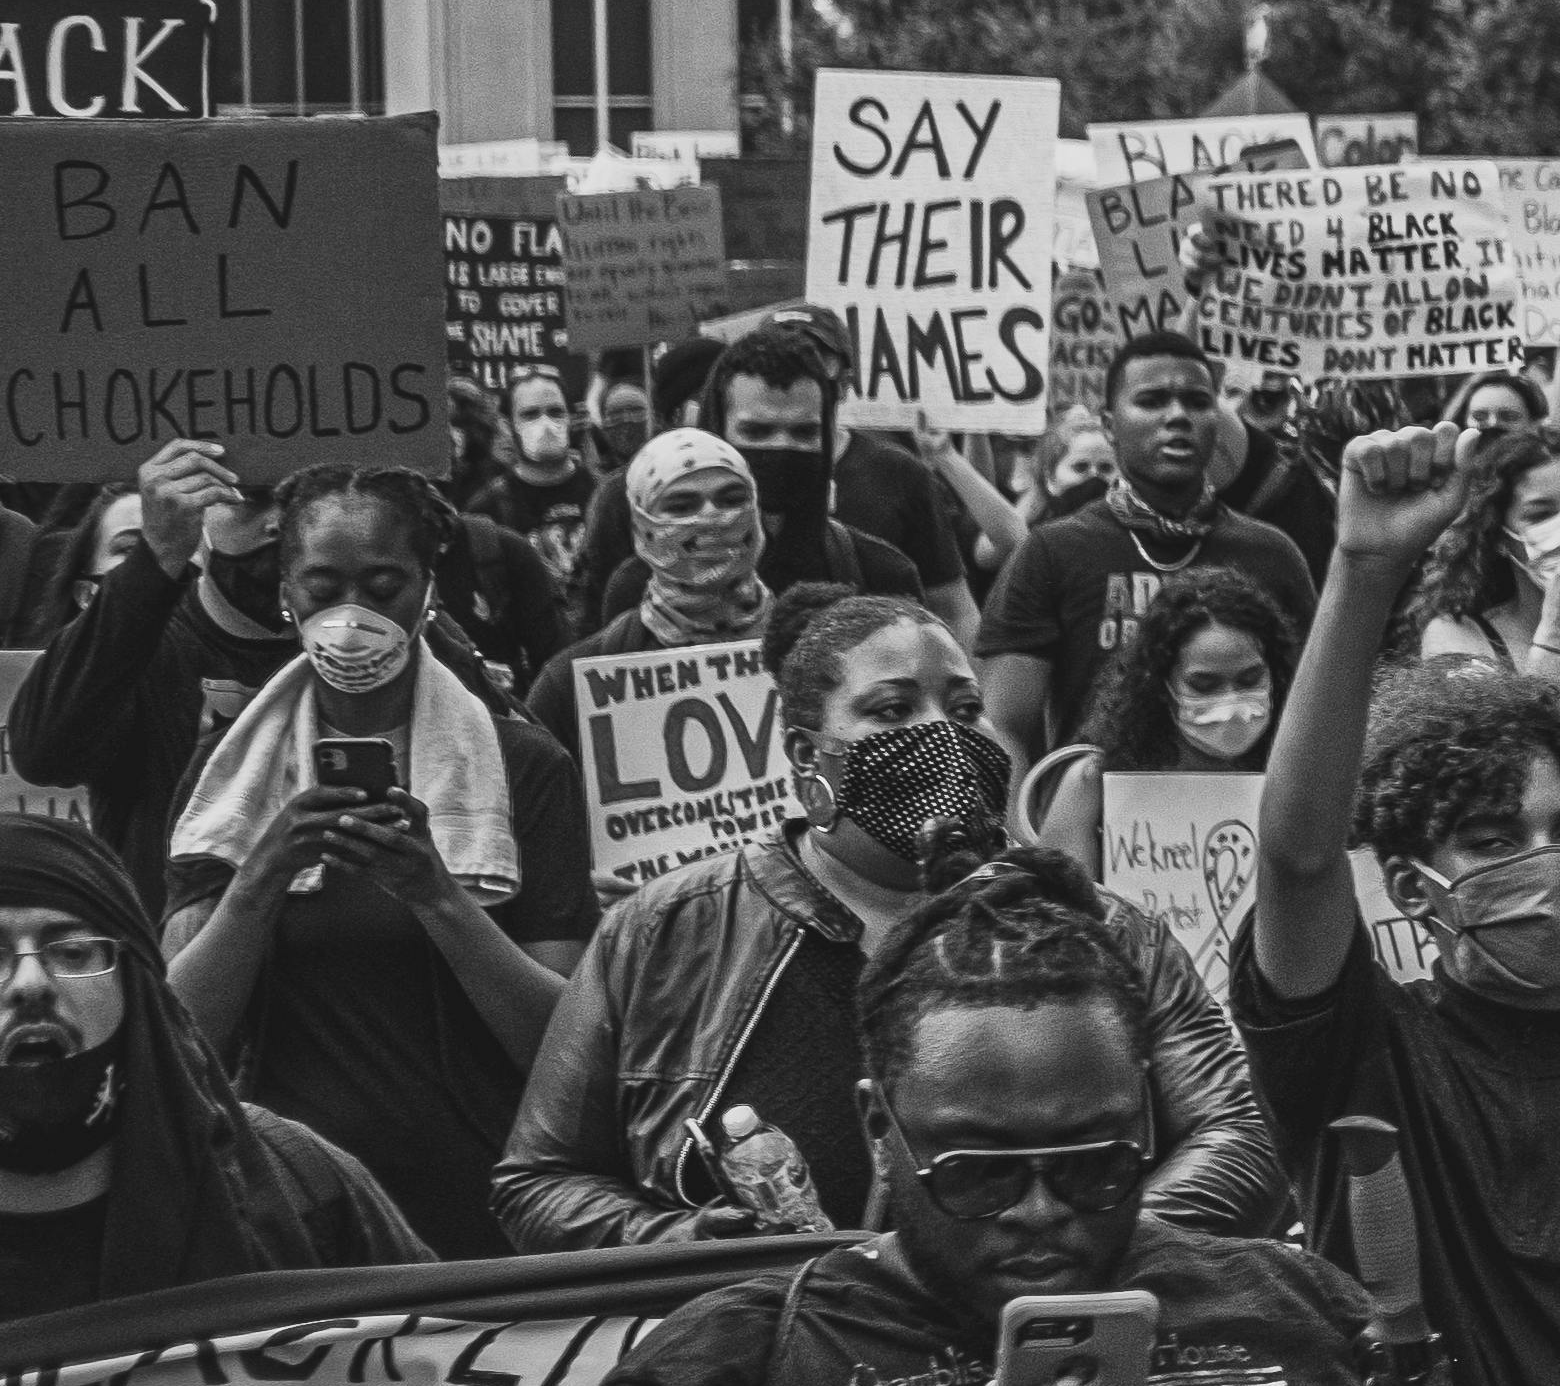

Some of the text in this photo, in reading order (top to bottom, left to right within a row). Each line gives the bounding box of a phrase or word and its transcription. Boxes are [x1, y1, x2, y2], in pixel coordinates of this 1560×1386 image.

[833, 96, 1001, 179] SAY
[54, 159, 299, 241] BAN
[1365, 171, 1409, 206] BE
[1431, 170, 1482, 200] NO
[446, 218, 564, 257] NO FLA
[822, 198, 1033, 292] THEIR
[1326, 215, 1344, 250] 4
[1368, 212, 1458, 244] BLACK
[1217, 240, 1307, 282] LIVES
[59, 253, 272, 334] ALL
[470, 321, 545, 357] SHAME
[1200, 295, 1374, 341] CENTURIES
[1425, 299, 1516, 336] BLACK
[1201, 325, 1302, 368] LIVES
[1406, 335, 1525, 371] MATTER
[8, 362, 431, 446] CHOKEHOLDS
[583, 659, 701, 709] WHEN
[588, 689, 778, 806] LOV
